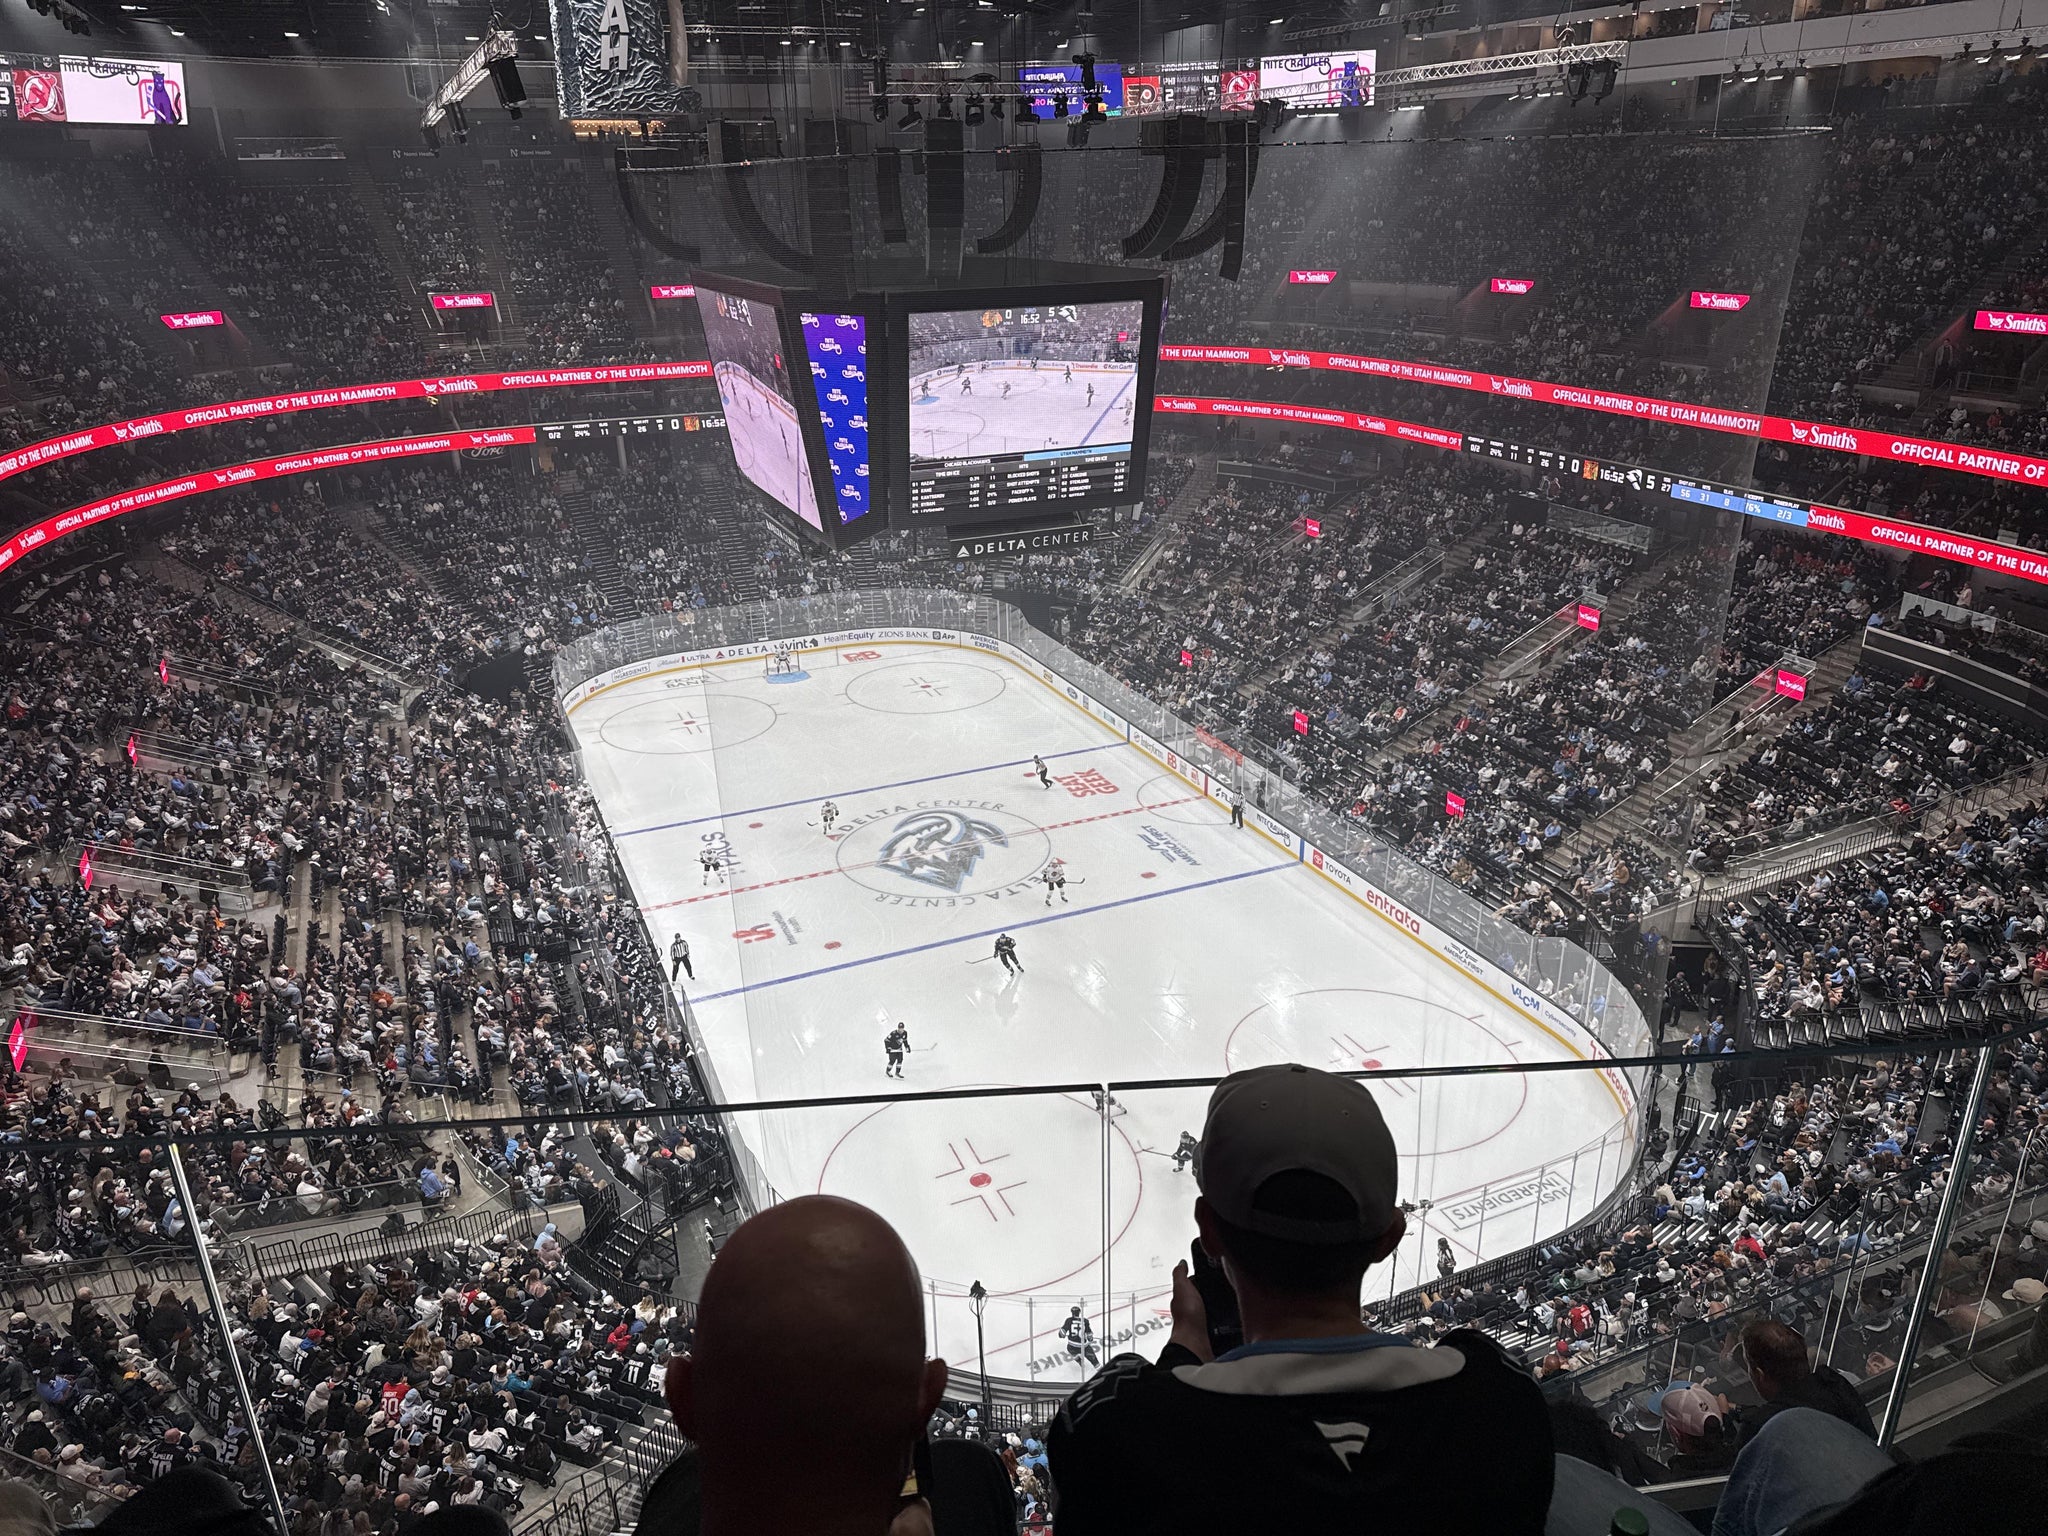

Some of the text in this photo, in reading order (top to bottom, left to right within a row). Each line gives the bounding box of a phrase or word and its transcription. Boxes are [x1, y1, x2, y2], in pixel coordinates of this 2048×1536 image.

[1165, 89, 1174, 101] 2
[1306, 272, 1328, 282] Smith's
[454, 295, 483, 306] Smith's
[1710, 296, 1740, 308] Smith's
[184, 315, 215, 326] Smith's
[1020, 314, 1040, 324] 16:52
[1048, 307, 1055, 316] 5
[2006, 314, 2046, 332] Smith's
[1166, 346, 1250, 360] THE UTAH MAMMOTH
[1282, 350, 1310, 366] Smith's
[502, 364, 708, 386] OFFICIAL PARTNER OF THE UTAH MAMMOTH
[1328, 356, 1472, 388] OFFICIAL PARTNER OF THE UTAH MAMMOTH
[438, 378, 478, 392] Smith's
[1502, 378, 1532, 398] Smith's
[184, 386, 396, 424] OFFICIAL PARTNER OF THE UTAH MAMMOTH
[1172, 400, 1196, 410] Smith's
[1212, 404, 1344, 422] OFFICIAL PARTNER OF THE UTAH MAMMOTH
[1552, 388, 1760, 432] OFFICIAL PARTNER OF THE UTAH MAMMOTH
[128, 420, 164, 438] Smith's
[671, 419, 679, 430] 0
[702, 419, 726, 428] 16:52
[482, 432, 514, 444] Smith's
[1398, 426, 1458, 446] OFFICIAL PARTNER OF
[1808, 426, 1858, 450] Smith's
[274, 440, 450, 472] OFFICIAL PARTNER OF THE UTAH MAMMOTH
[1892, 442, 2046, 480] OFFICIAL PARTNER OF
[226, 468, 256, 482] Smith's
[1571, 459, 1579, 473] 0
[1600, 469, 1624, 484] 16:52
[1646, 475, 1655, 489] 5
[1661, 484, 1671, 492] 27
[1680, 489, 1690, 498] 56
[1700, 493, 1710, 502] 31
[1777, 510, 1792, 520] 2/3
[56, 480, 196, 532] OFFICIAL PARTNER OF THE UTAH MAMMOTH
[1808, 508, 1846, 530] Smith's
[974, 530, 1090, 556] DELTA CENTER
[1872, 526, 2048, 578] OFFICIAL PARTNER OF THE UTAH
[824, 631, 874, 644] HealthEquity
[906, 631, 929, 639] BANK
[970, 634, 999, 646] AMERICAN
[728, 644, 768, 658] DELTA
[974, 641, 1000, 652] EXPRESS
[686, 654, 710, 662] ULTRA
[1074, 768, 1120, 794] GEEK
[839, 800, 1004, 833] DELTA CENTER
[1325, 862, 1352, 886] TOYOTA
[874, 892, 976, 908] CENTER
[1366, 889, 1420, 936] entrata
[1444, 945, 1484, 976] AMERICA FIRST
[1452, 1176, 1562, 1220] INGREDIENTS
[1540, 1186, 1570, 1206] JUST
[432, 1415, 442, 1434] 9
